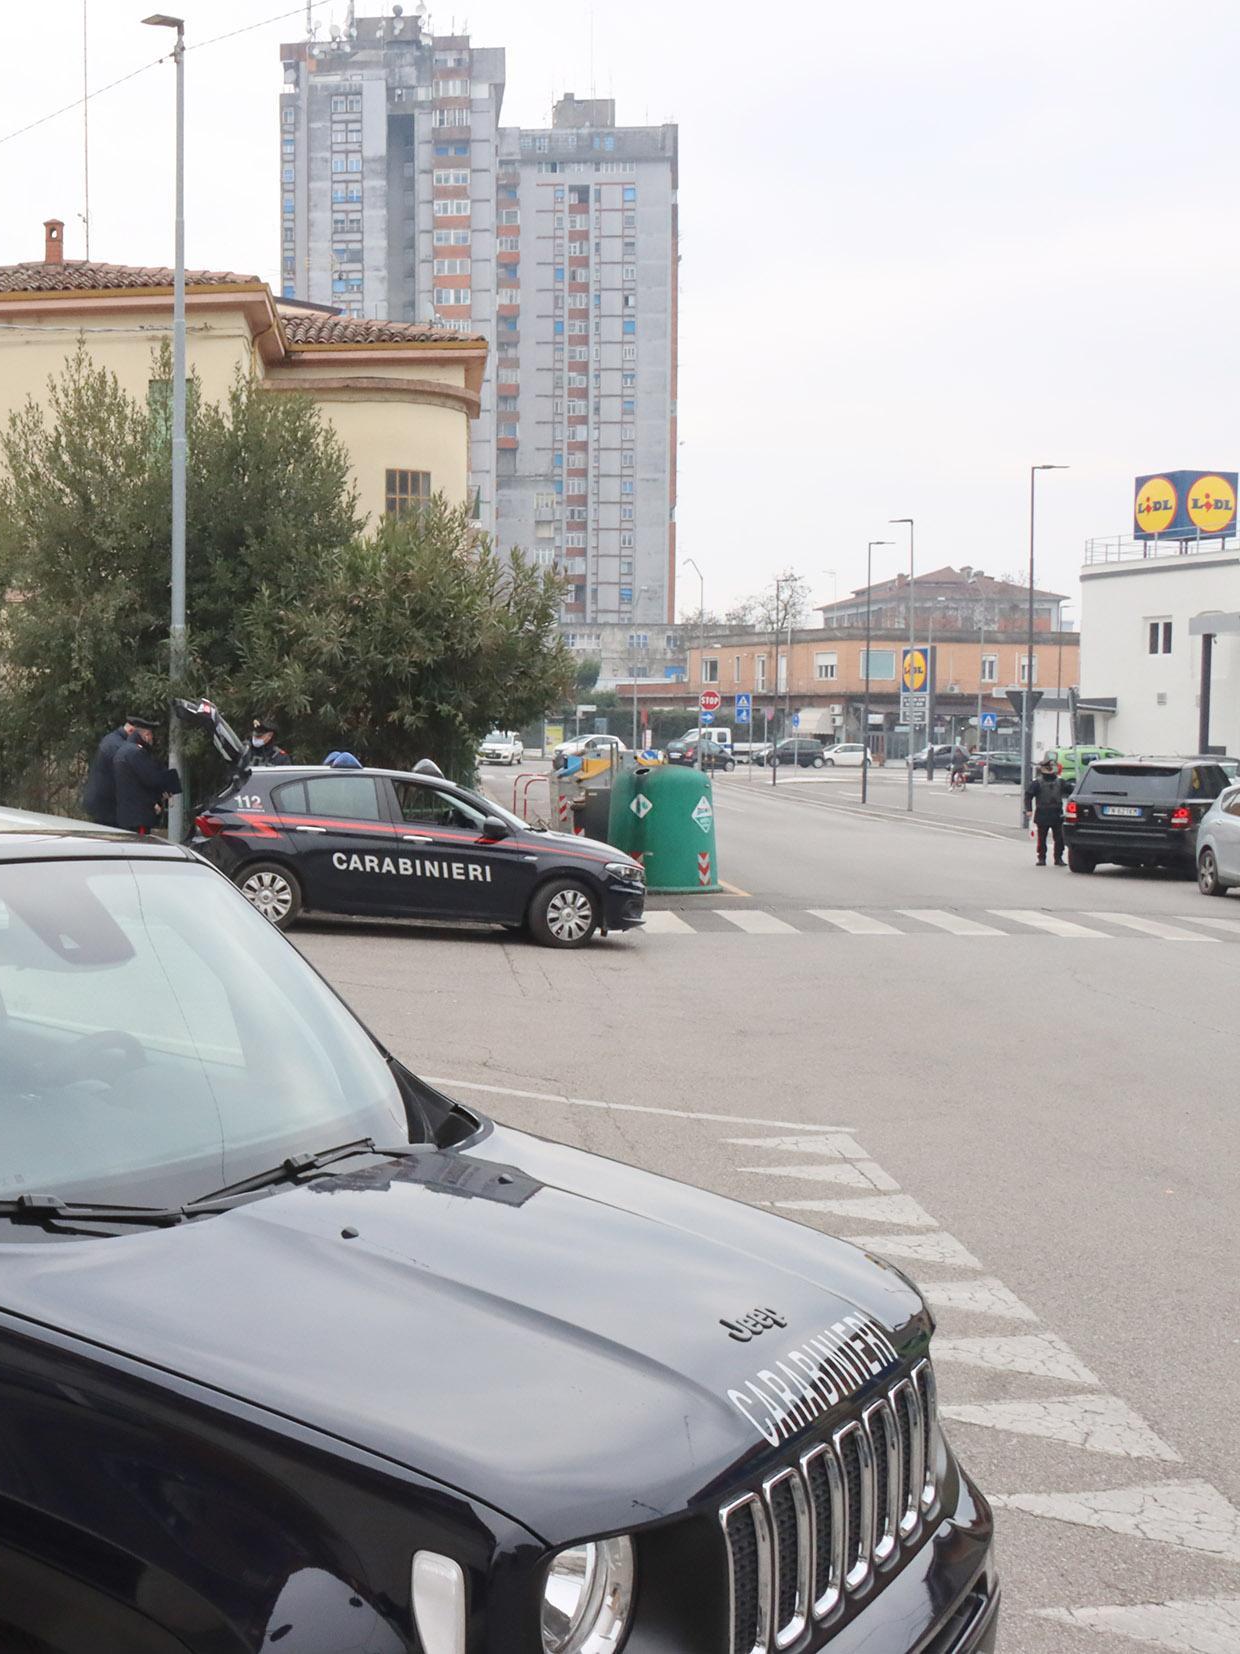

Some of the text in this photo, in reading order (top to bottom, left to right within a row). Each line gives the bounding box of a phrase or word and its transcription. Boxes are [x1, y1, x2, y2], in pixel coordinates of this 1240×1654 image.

[701, 696, 719, 705] STOP
[233, 795, 264, 808] 112
[332, 852, 492, 882] CARABINIERI
[719, 1308, 788, 1343] Jeep
[727, 1311, 899, 1448] CARABINIERI
